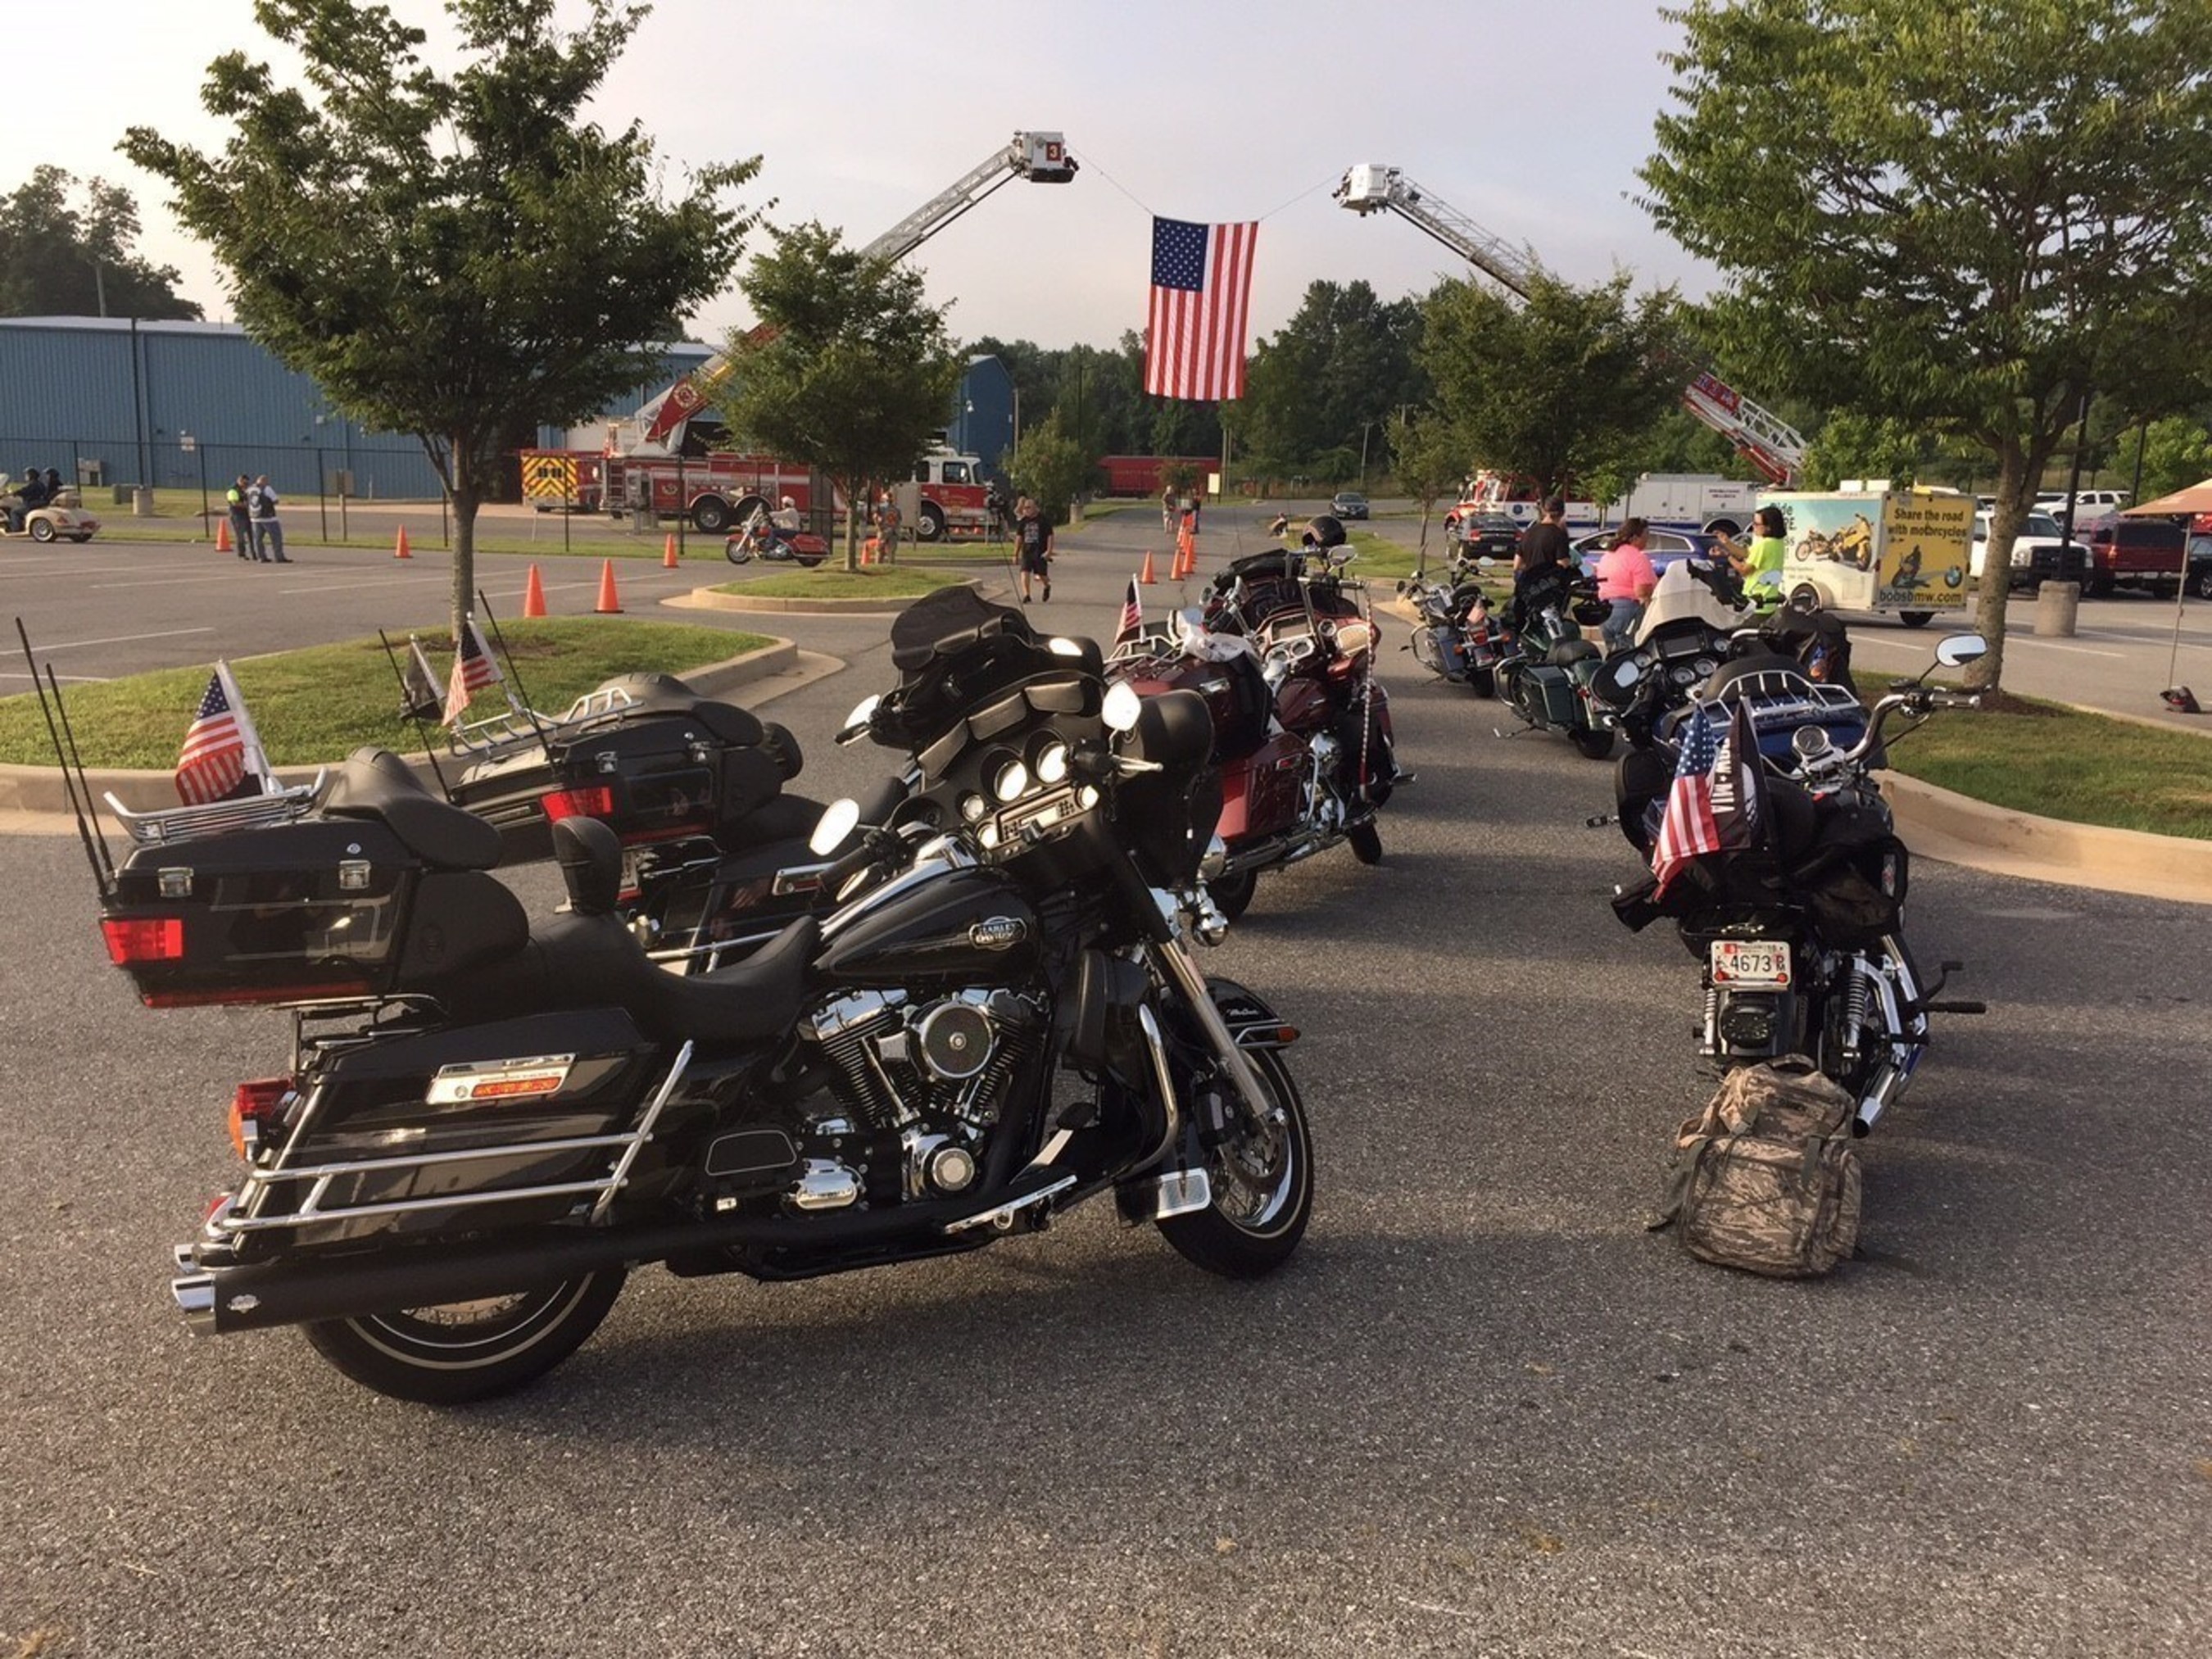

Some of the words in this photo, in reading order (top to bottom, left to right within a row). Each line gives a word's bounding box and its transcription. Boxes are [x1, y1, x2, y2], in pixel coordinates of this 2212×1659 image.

[1049, 145, 1058, 158] 3
[1894, 508, 1922, 520] Share
[1924, 510, 1939, 520] the
[1942, 511, 1964, 522] road
[1888, 524, 1907, 534] with
[1910, 525, 1967, 539] motorcycles
[1880, 591, 1962, 602] bobsbmw.com
[1710, 783, 1735, 814] MIA
[1730, 954, 1771, 972] 4673
